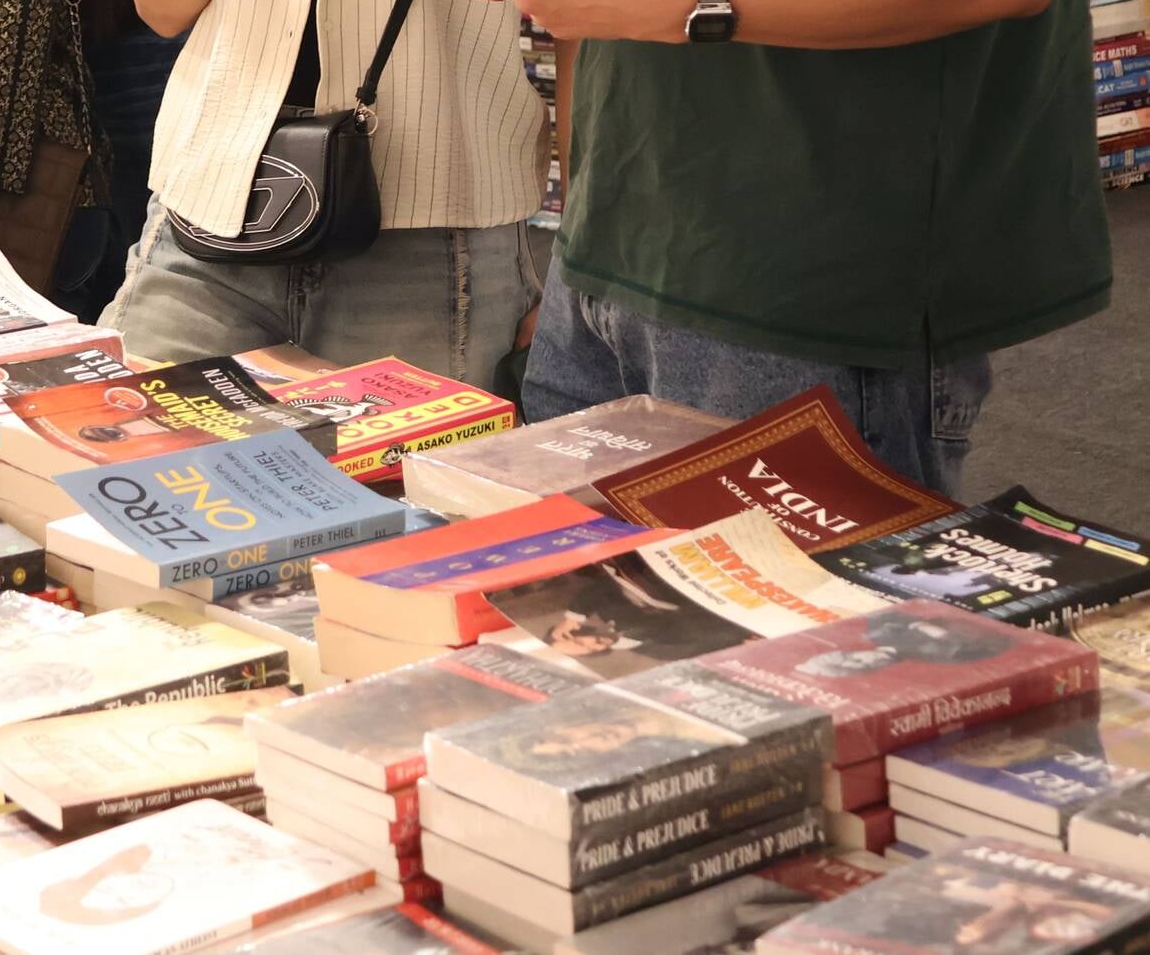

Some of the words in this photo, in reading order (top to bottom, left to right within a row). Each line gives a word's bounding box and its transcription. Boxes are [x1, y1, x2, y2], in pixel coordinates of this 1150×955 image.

[1108, 45, 1138, 59] MATHS
[336, 395, 478, 439] OOKED
[416, 433, 453, 453] ASAKO
[455, 422, 496, 442] YUZUKI
[253, 450, 293, 483] THIEL
[97, 475, 210, 551] ZERO
[154, 465, 257, 531] ONE
[291, 484, 338, 511] PETER
[747, 457, 861, 534] INDIA
[293, 532, 326, 550] PETER
[327, 526, 355, 544] THIEL
[940, 528, 1053, 570] Holmes
[172, 557, 219, 583] ZERO
[226, 545, 269, 570] ONE
[224, 569, 271, 596] ZERO
[924, 543, 1058, 593] Sherlock
[583, 795, 625, 824] PRIDE
[629, 791, 640, 811] &
[642, 764, 717, 804] PREJUDICE
[580, 844, 621, 872] PRIDE
[623, 836, 634, 854] &
[636, 810, 710, 849] PREJUDICE
[762, 840, 774, 857] &
[777, 820, 818, 853] PRIDE
